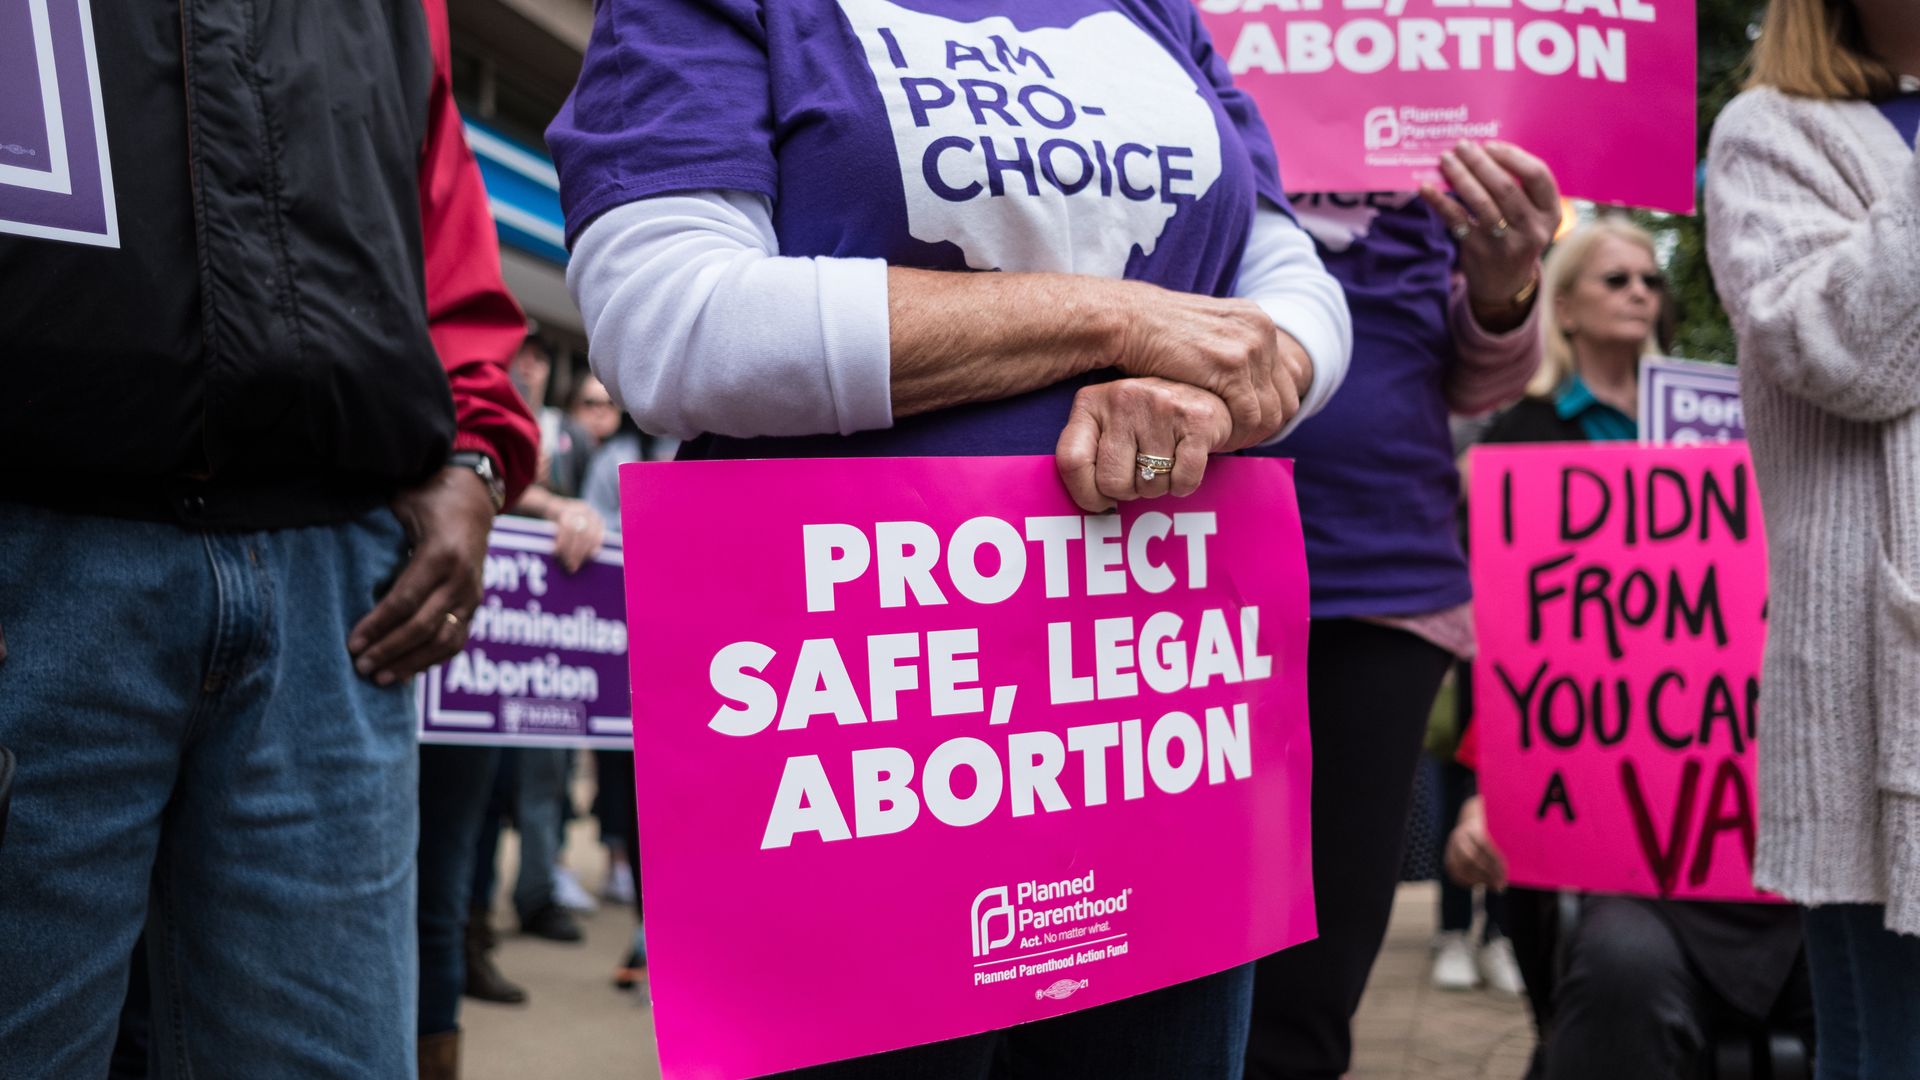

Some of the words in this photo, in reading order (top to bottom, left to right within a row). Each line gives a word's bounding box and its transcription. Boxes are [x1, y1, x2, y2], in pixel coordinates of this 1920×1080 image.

[877, 28, 908, 68] I
[945, 35, 1055, 79] AM
[1228, 19, 1627, 82] ABORTION
[900, 77, 1106, 130] PRO-
[922, 135, 1197, 202] CHOICE
[1503, 468, 1514, 545] I
[483, 551, 548, 596] on't
[802, 511, 1218, 612] PROTECT
[469, 594, 628, 655] riminalize
[1529, 553, 1728, 659] FROM
[446, 648, 598, 702] Abortion
[707, 627, 1018, 737] SAFE,
[1047, 606, 1273, 705] LEGAL
[1493, 660, 1632, 750] YOU
[760, 702, 1252, 850] ABORTION
[1536, 770, 1576, 822] A
[1017, 869, 1095, 905] Planned
[1019, 889, 1128, 932] Parenthood
[1020, 937, 1043, 949] Act.
[1044, 933, 1057, 944] No
[1058, 926, 1088, 941] matter
[1088, 921, 1111, 934] what.
[974, 966, 1017, 986] Planned
[1019, 954, 1075, 977] Parenthood
[1076, 949, 1106, 965] Action
[1106, 942, 1128, 958] Fund
